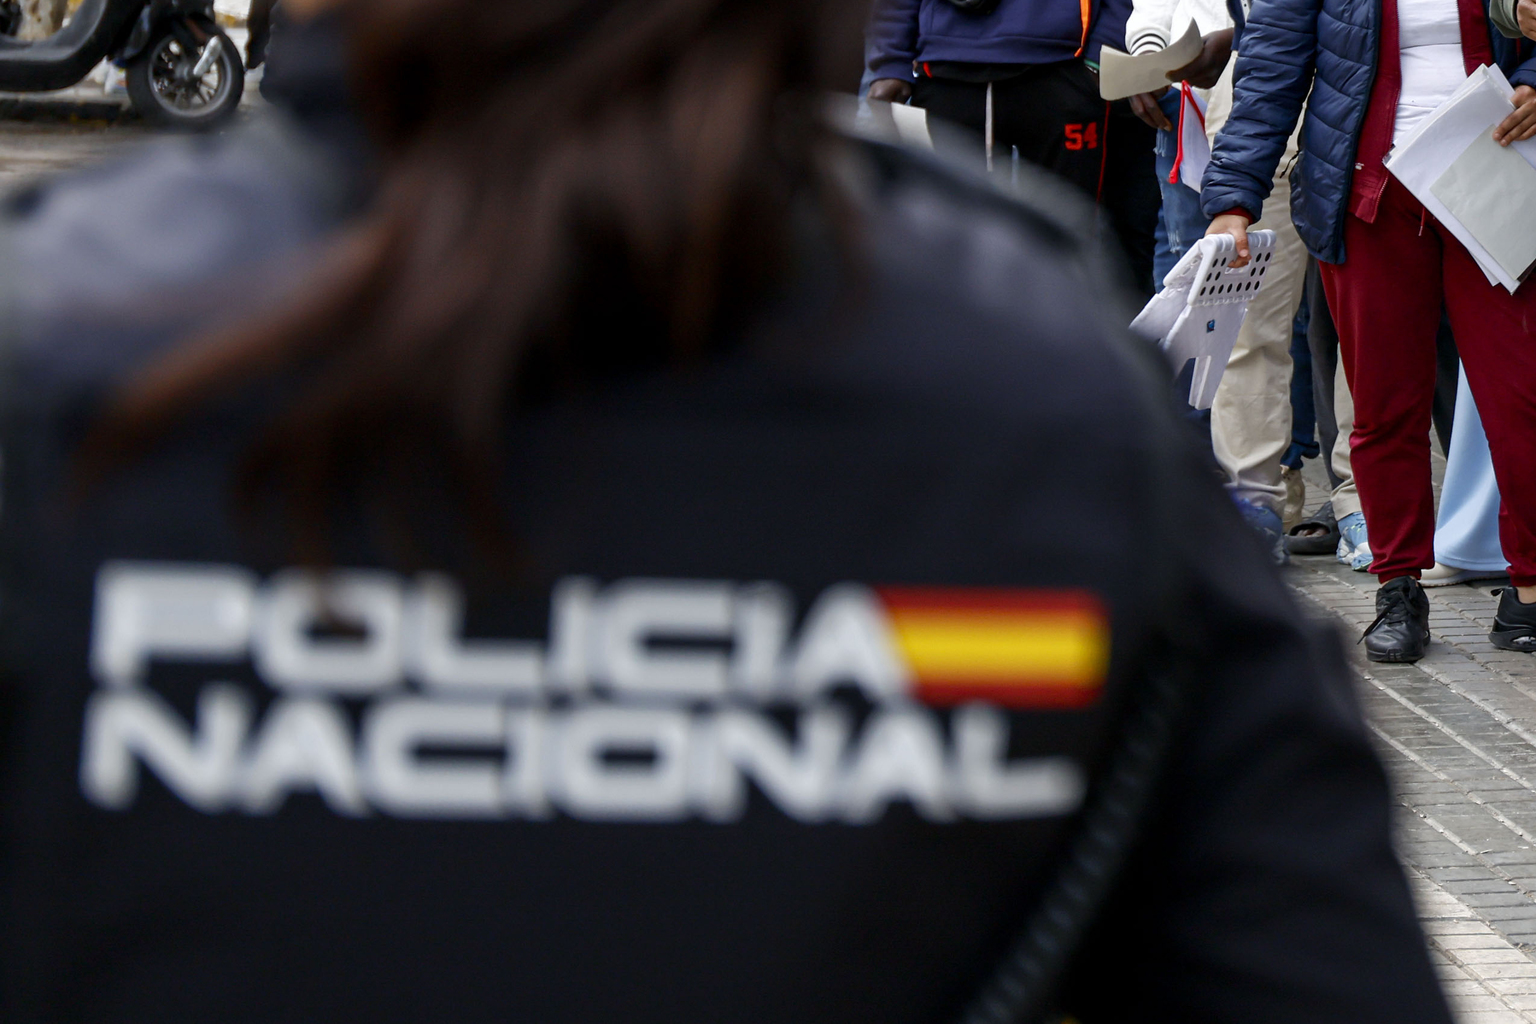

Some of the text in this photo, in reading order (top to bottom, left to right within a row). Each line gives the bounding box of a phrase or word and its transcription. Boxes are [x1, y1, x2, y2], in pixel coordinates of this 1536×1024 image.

[1064, 122, 1098, 151] 54
[91, 561, 922, 705] POLICIA
[80, 684, 1086, 822] NACIONAL
